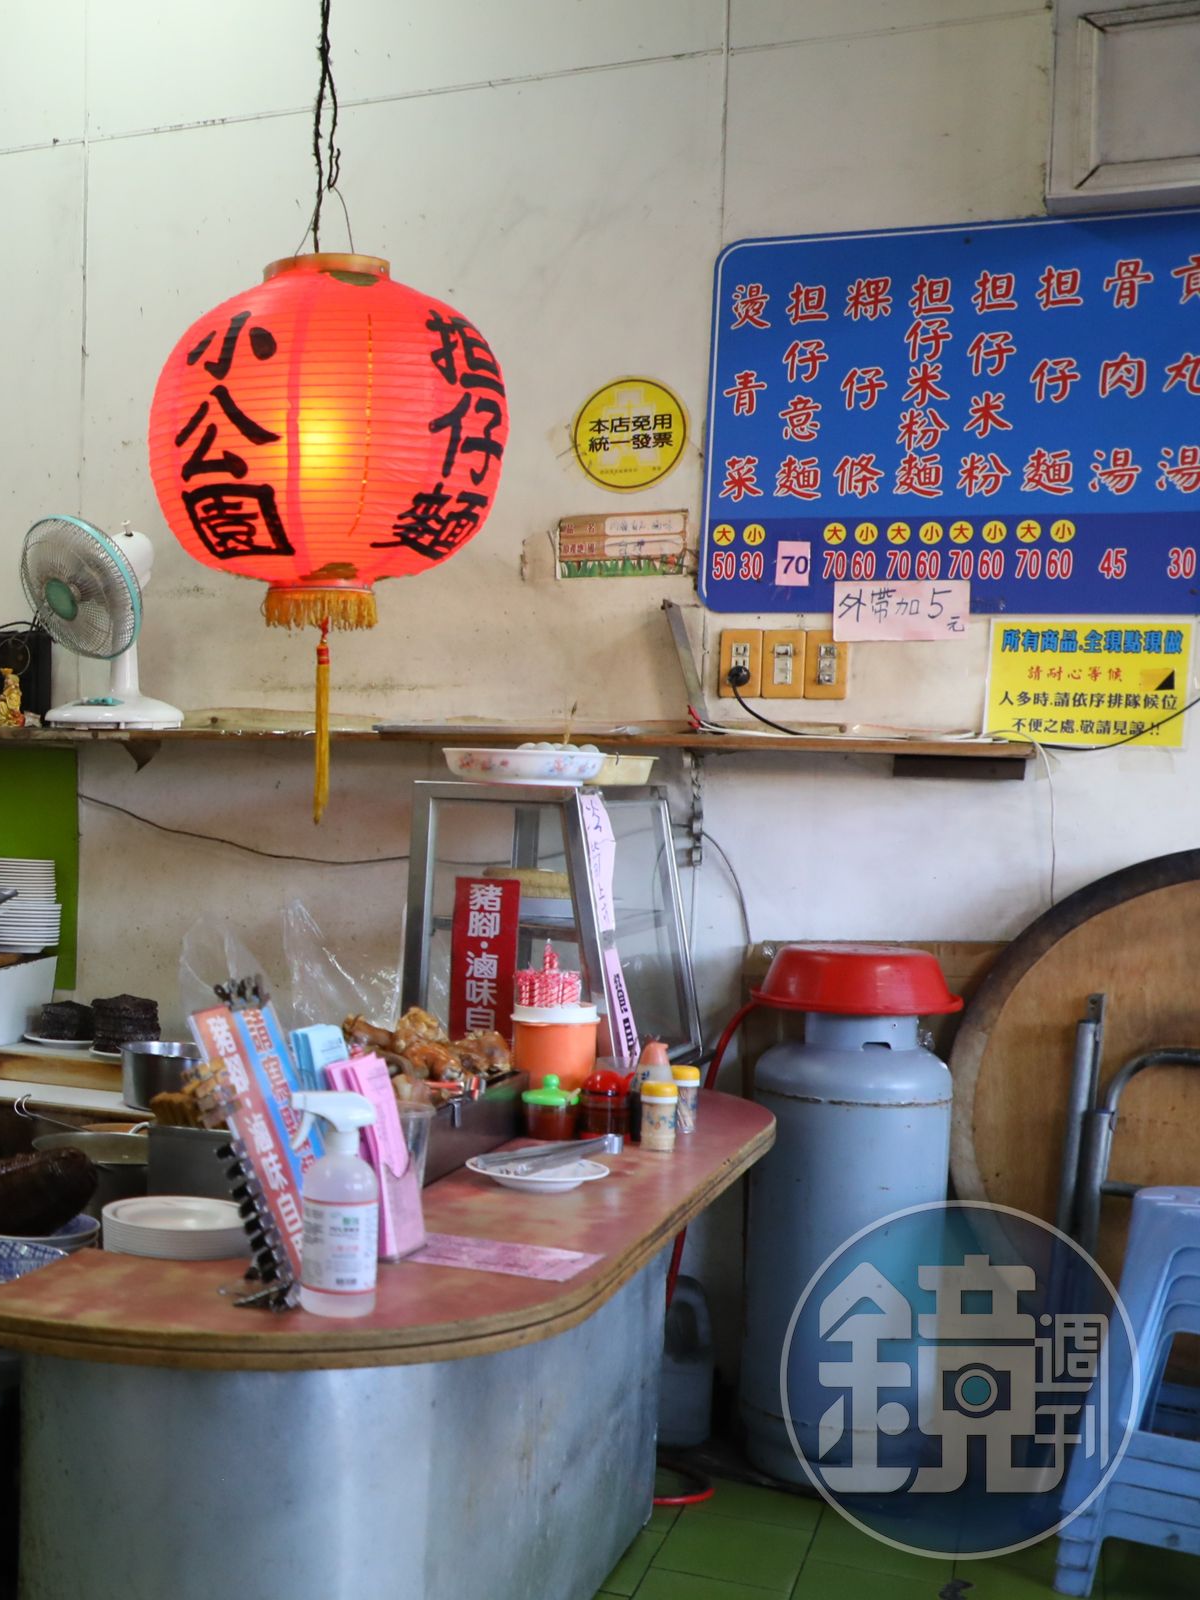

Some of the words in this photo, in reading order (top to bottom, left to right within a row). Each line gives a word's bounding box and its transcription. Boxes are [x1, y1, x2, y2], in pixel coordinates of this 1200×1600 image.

[719, 283, 771, 502] 燙青菜
[773, 282, 829, 500] 担仔意麵
[833, 276, 893, 498] 粿仔條
[893, 274, 954, 498] 担仔米粉麵
[957, 270, 1018, 497] 担仔米粉
[1020, 265, 1084, 496] 担仔麵
[1088, 258, 1154, 496] 骨肉湯
[175, 310, 296, 561] 小公園
[371, 308, 506, 561] 担仔麵
[588, 413, 673, 435] 本店免用
[588, 431, 674, 453] 統一發票
[712, 551, 736, 580] 50
[739, 551, 764, 580] 30
[781, 556, 808, 575] 70
[822, 550, 847, 580] 70
[851, 550, 876, 580] 60
[886, 550, 911, 580] 70
[916, 550, 941, 580] 60
[948, 549, 974, 580] 70
[978, 549, 1005, 580] 60
[1015, 549, 1041, 579] 70
[1046, 548, 1073, 579] 60
[1099, 548, 1127, 579] 45
[1167, 547, 1196, 579] 30
[838, 587, 965, 632] 外帶加5元
[1027, 666, 1124, 683] 請耐心等候
